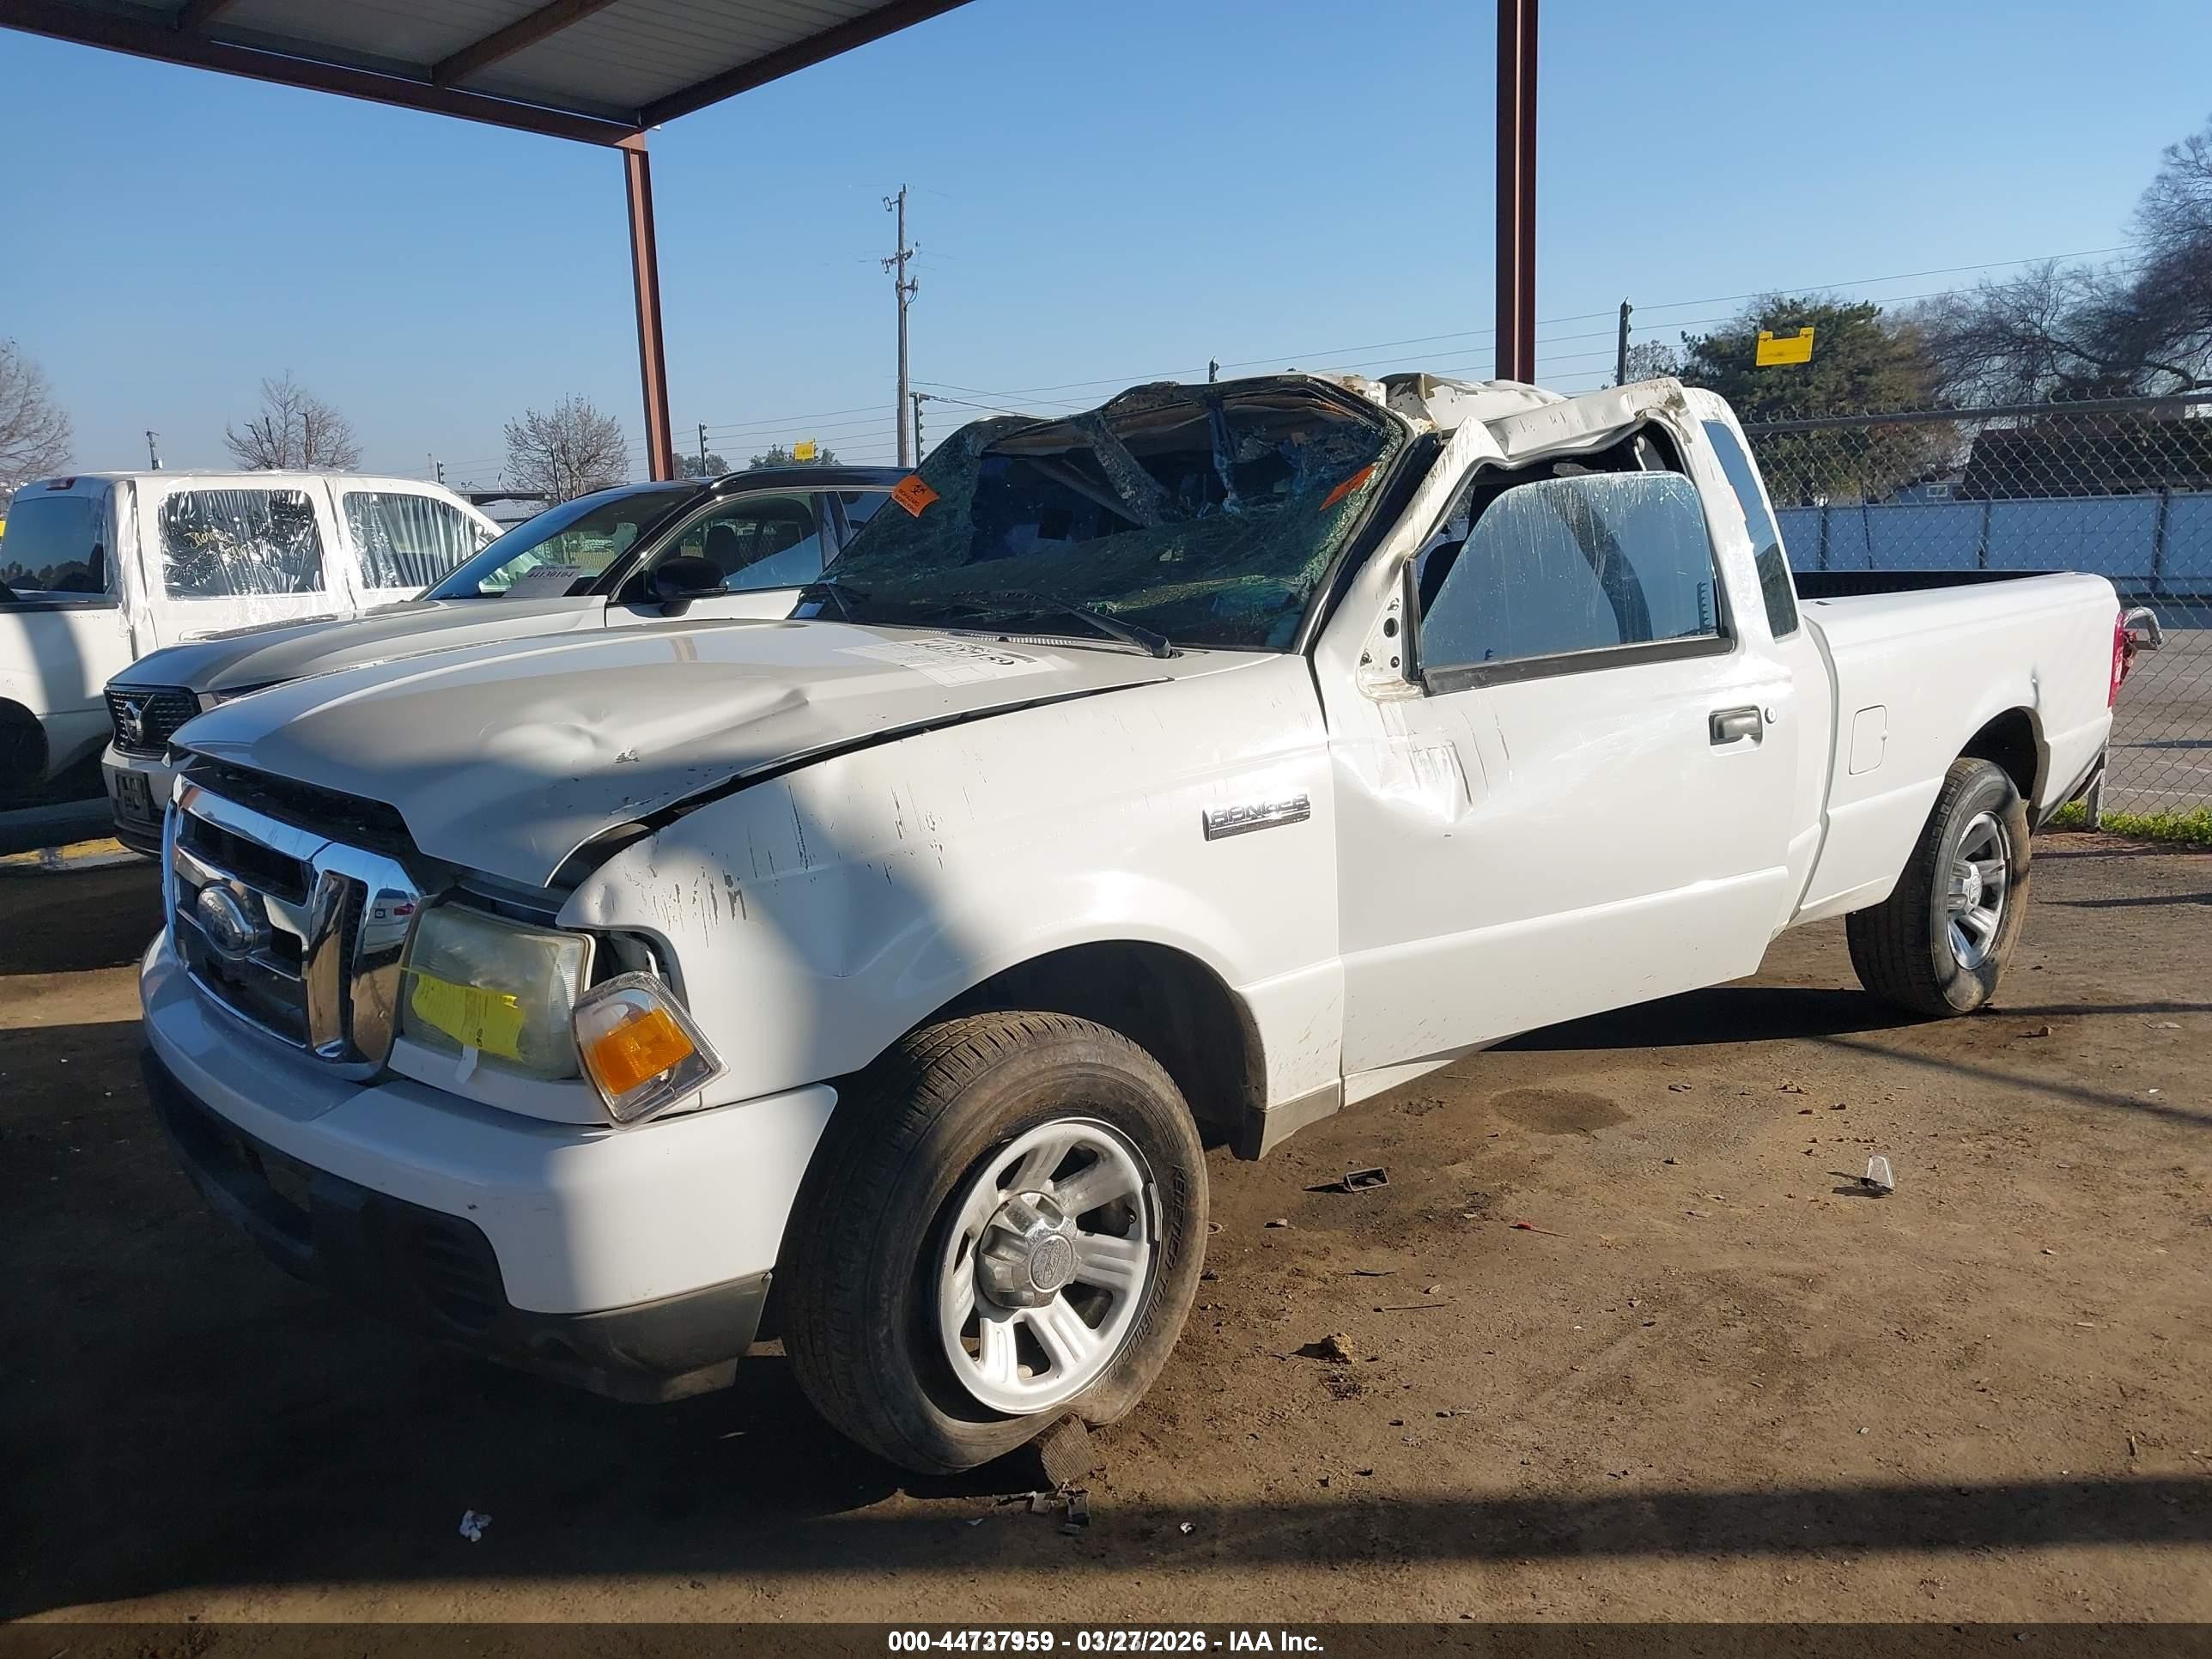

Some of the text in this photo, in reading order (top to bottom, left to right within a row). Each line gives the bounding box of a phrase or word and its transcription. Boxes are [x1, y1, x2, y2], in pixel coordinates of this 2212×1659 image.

[1210, 793, 1310, 827] RANGER
[1164, 1164, 1186, 1271] KENETICA
[1121, 1275, 1170, 1367] TOURING
